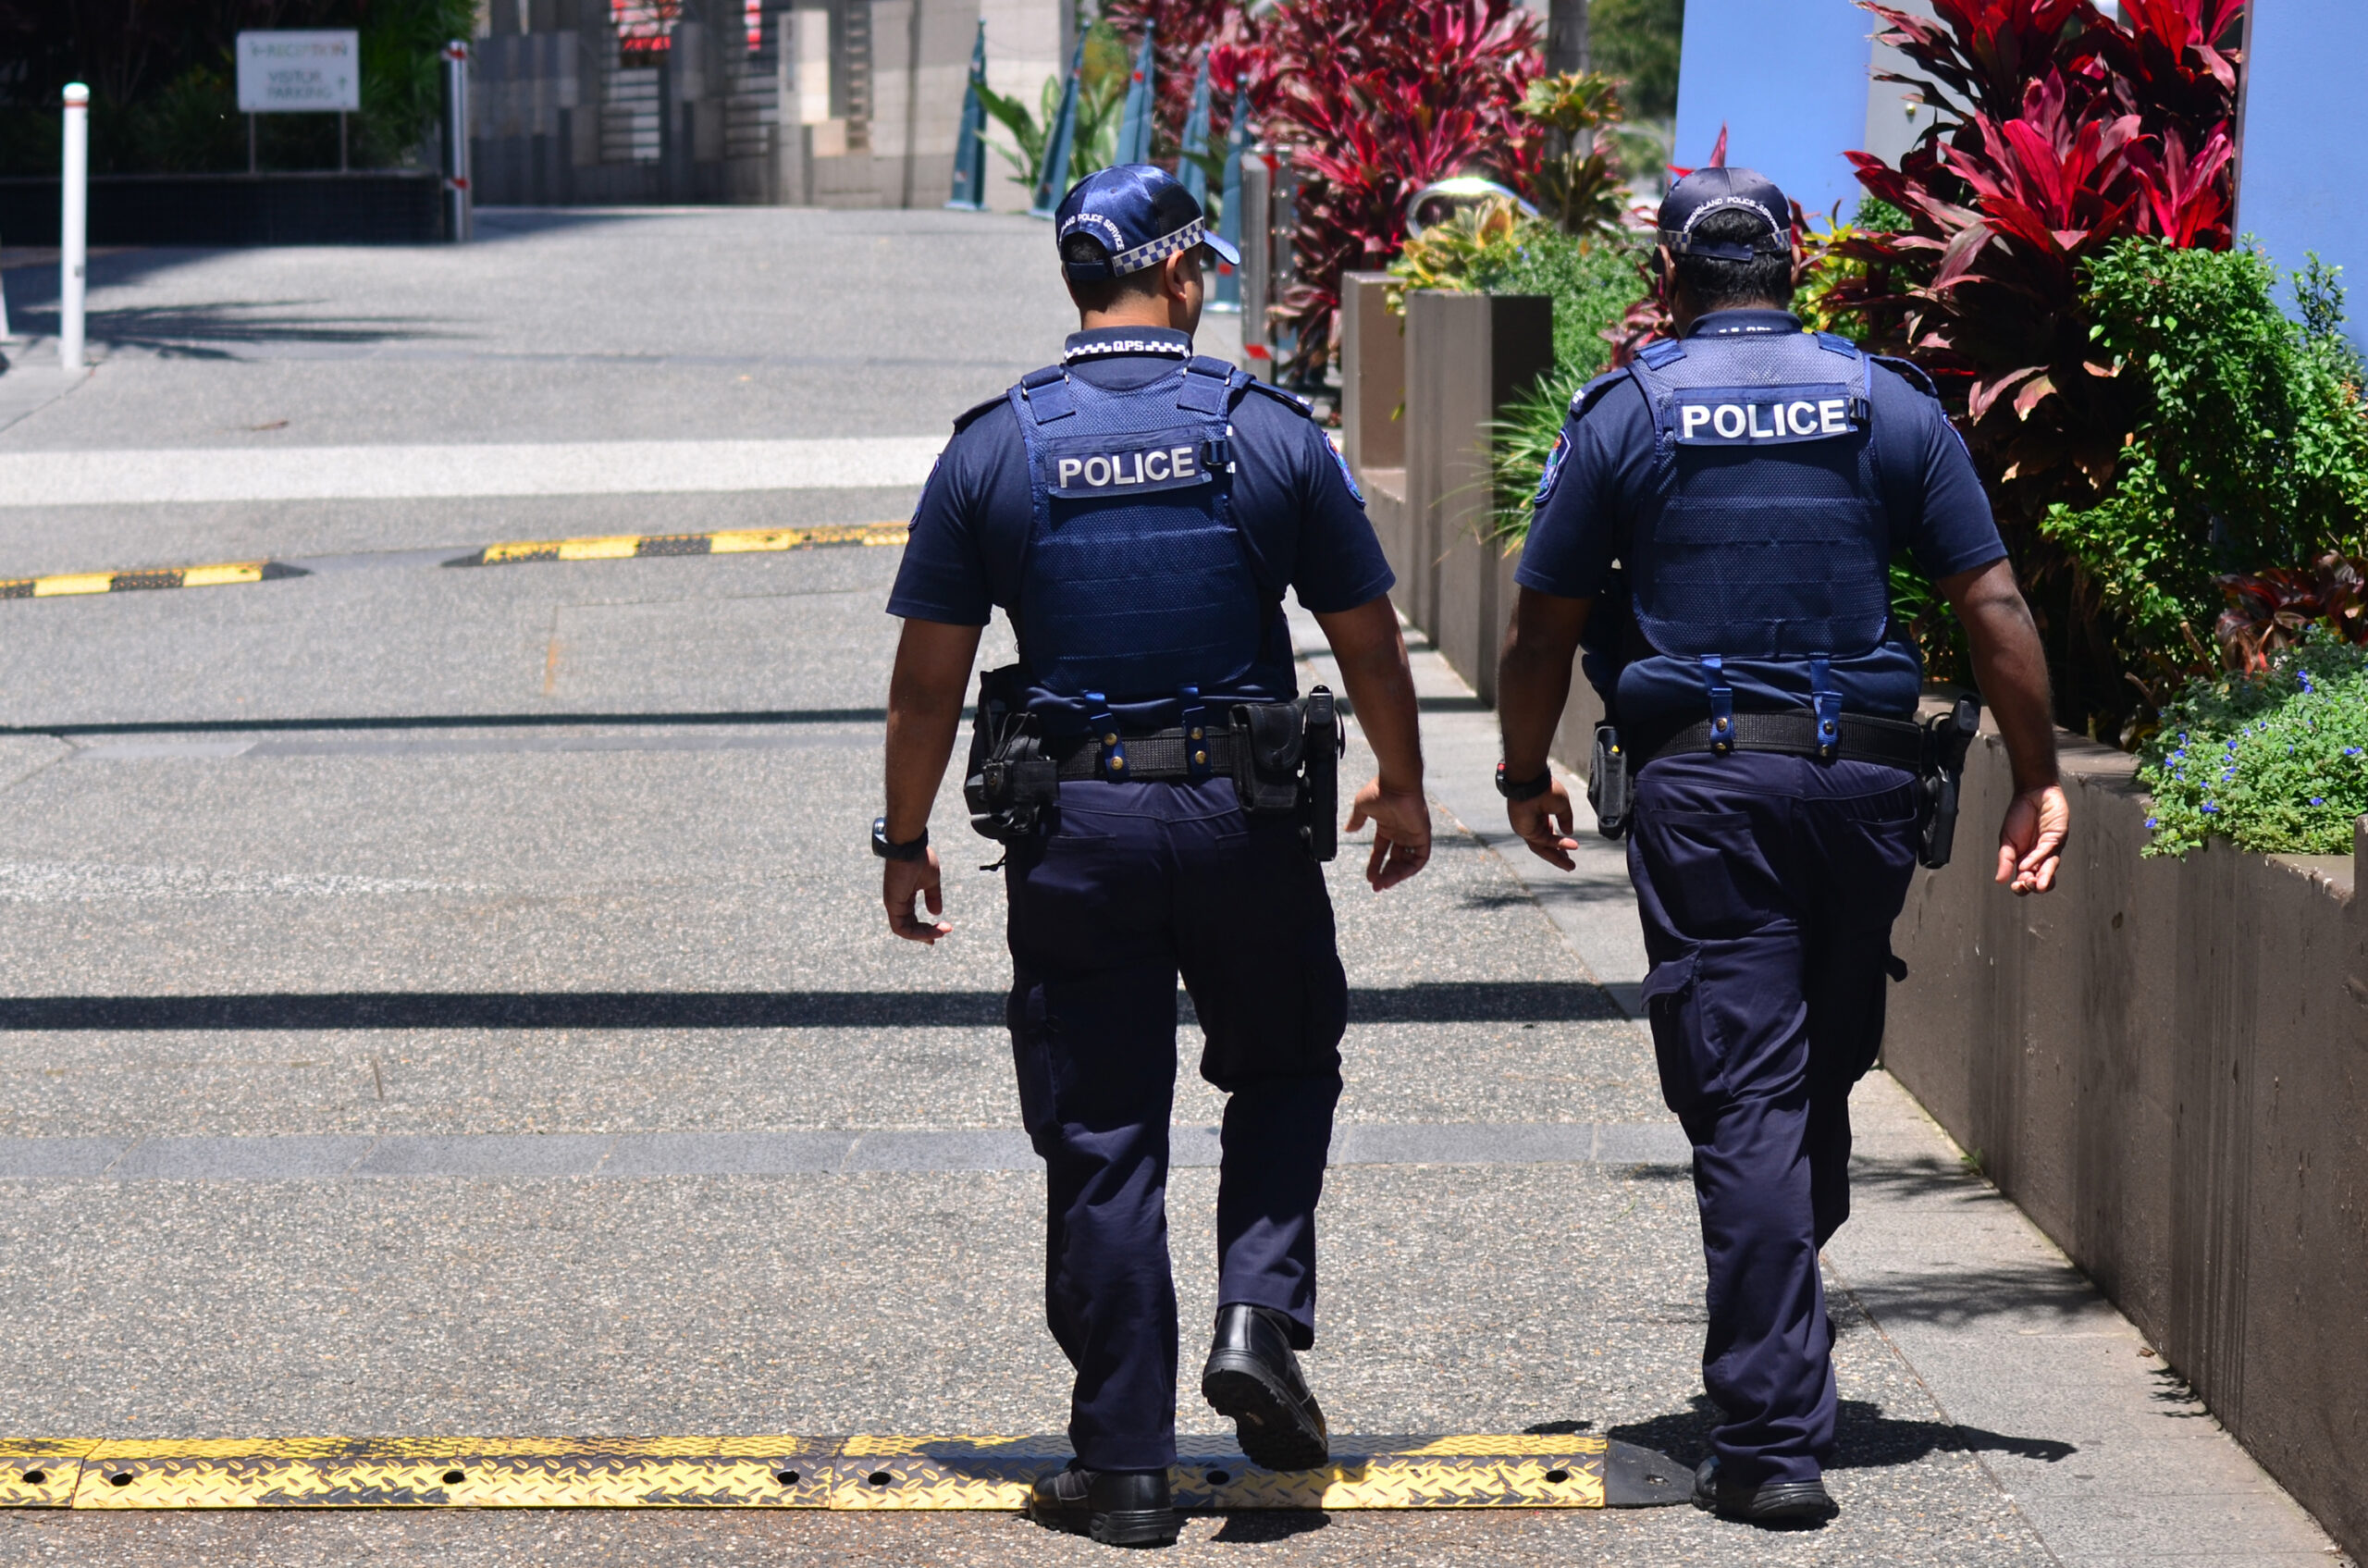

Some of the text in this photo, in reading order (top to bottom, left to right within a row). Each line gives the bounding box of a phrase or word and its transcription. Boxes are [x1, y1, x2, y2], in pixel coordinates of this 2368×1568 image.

[1727, 196, 1756, 207] POLICE
[1077, 213, 1104, 223] POLICE
[1103, 218, 1125, 252] SERVICE
[1113, 340, 1145, 352] QPS
[1682, 399, 1847, 439] POLICE
[1058, 447, 1195, 488] POLICE
